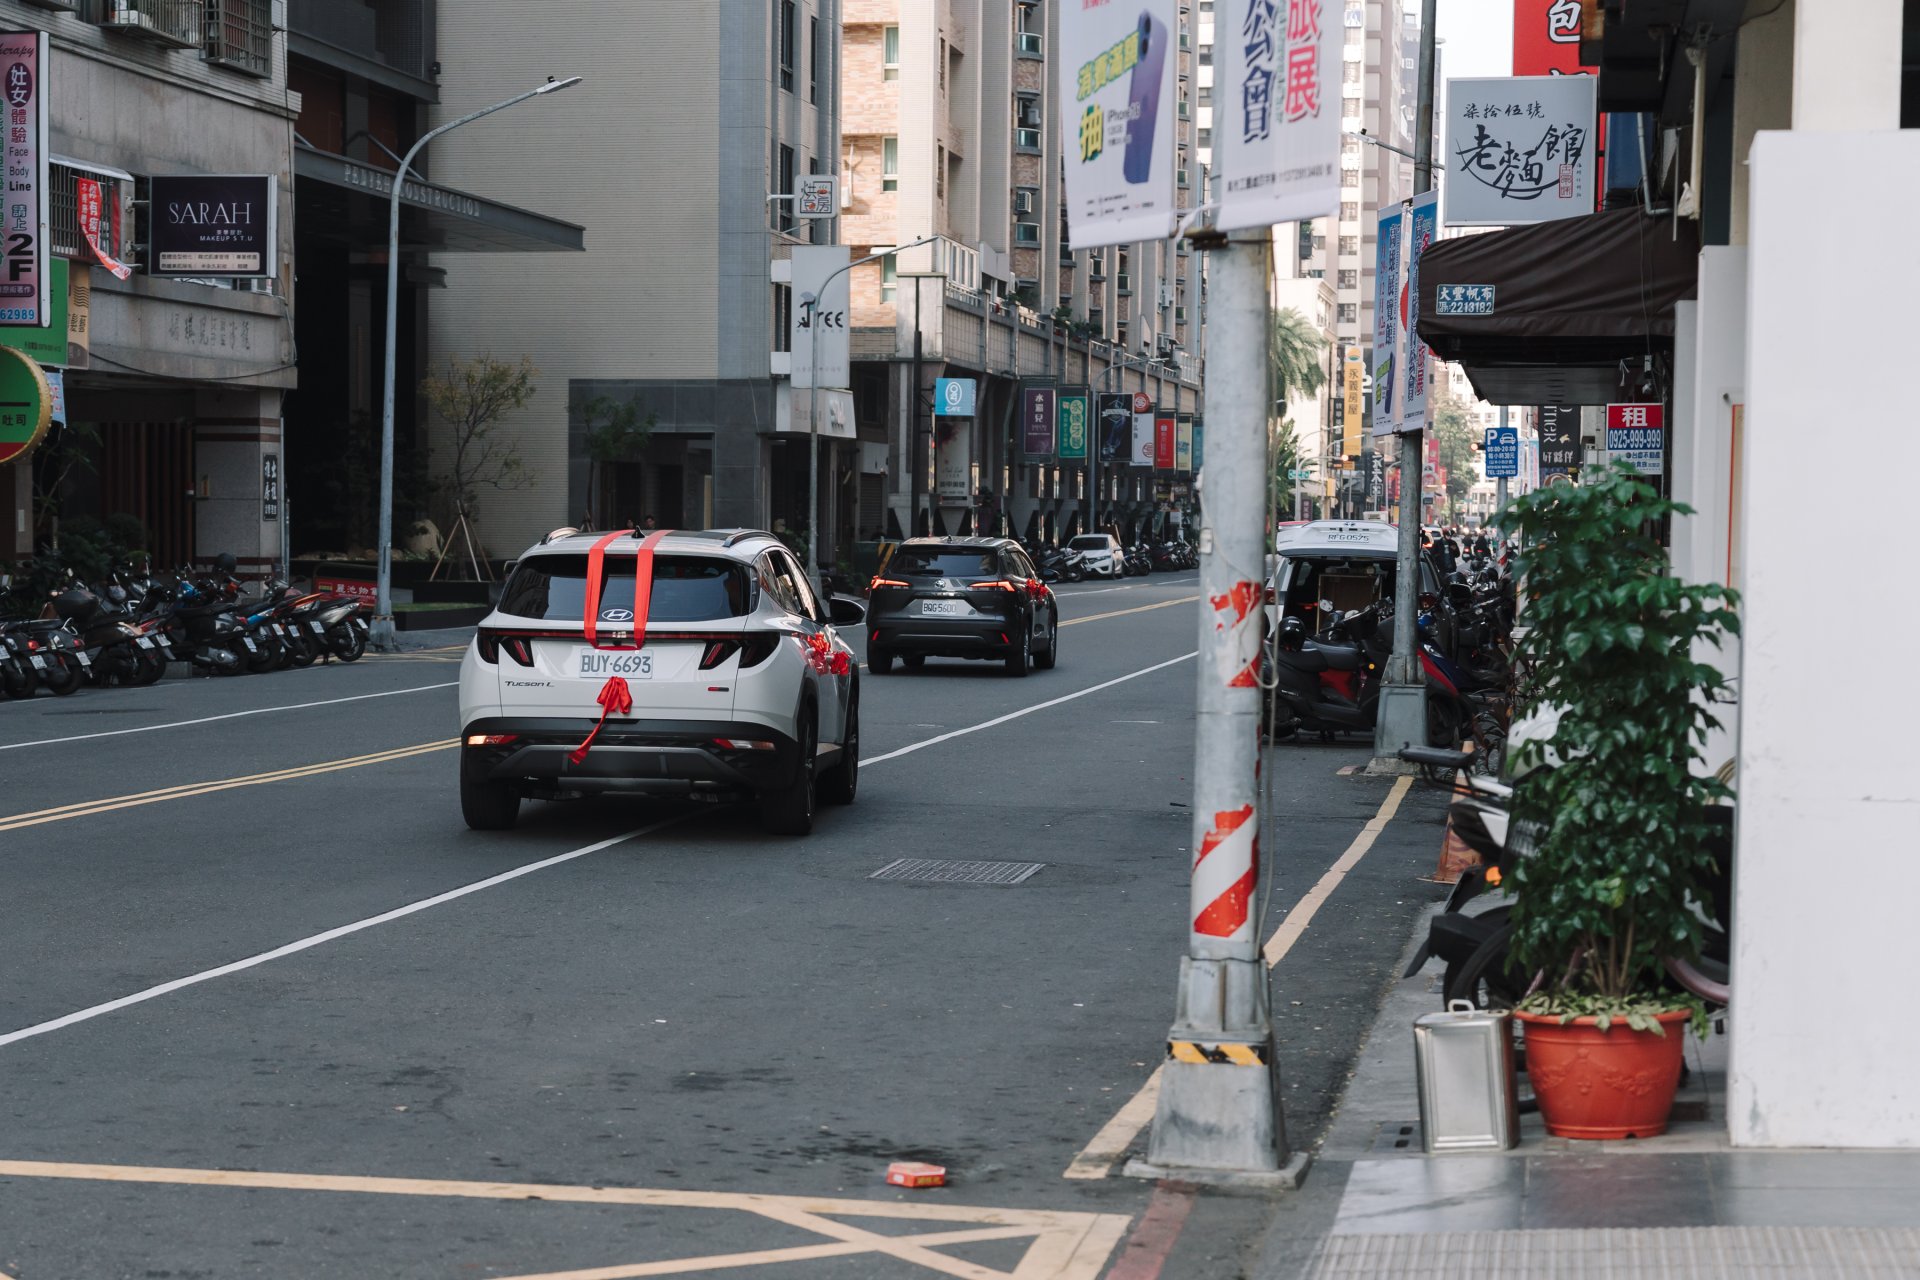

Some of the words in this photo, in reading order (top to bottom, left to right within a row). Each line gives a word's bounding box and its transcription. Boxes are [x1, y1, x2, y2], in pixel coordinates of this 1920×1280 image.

[1463, 101, 1545, 119] 柒拾伍號
[11, 109, 27, 143] 體驗
[1080, 102, 1104, 163] 抽
[9, 147, 28, 156] Face
[9, 166, 29, 178] Body
[9, 181, 31, 191] Line
[169, 202, 252, 225] SARAH
[1440, 286, 1493, 301] 大豐帆布
[2, 414, 26, 425] 吐司
[1622, 407, 1648, 427] 租
[1487, 430, 1498, 445] P
[1609, 429, 1661, 449] 0925-999-999
